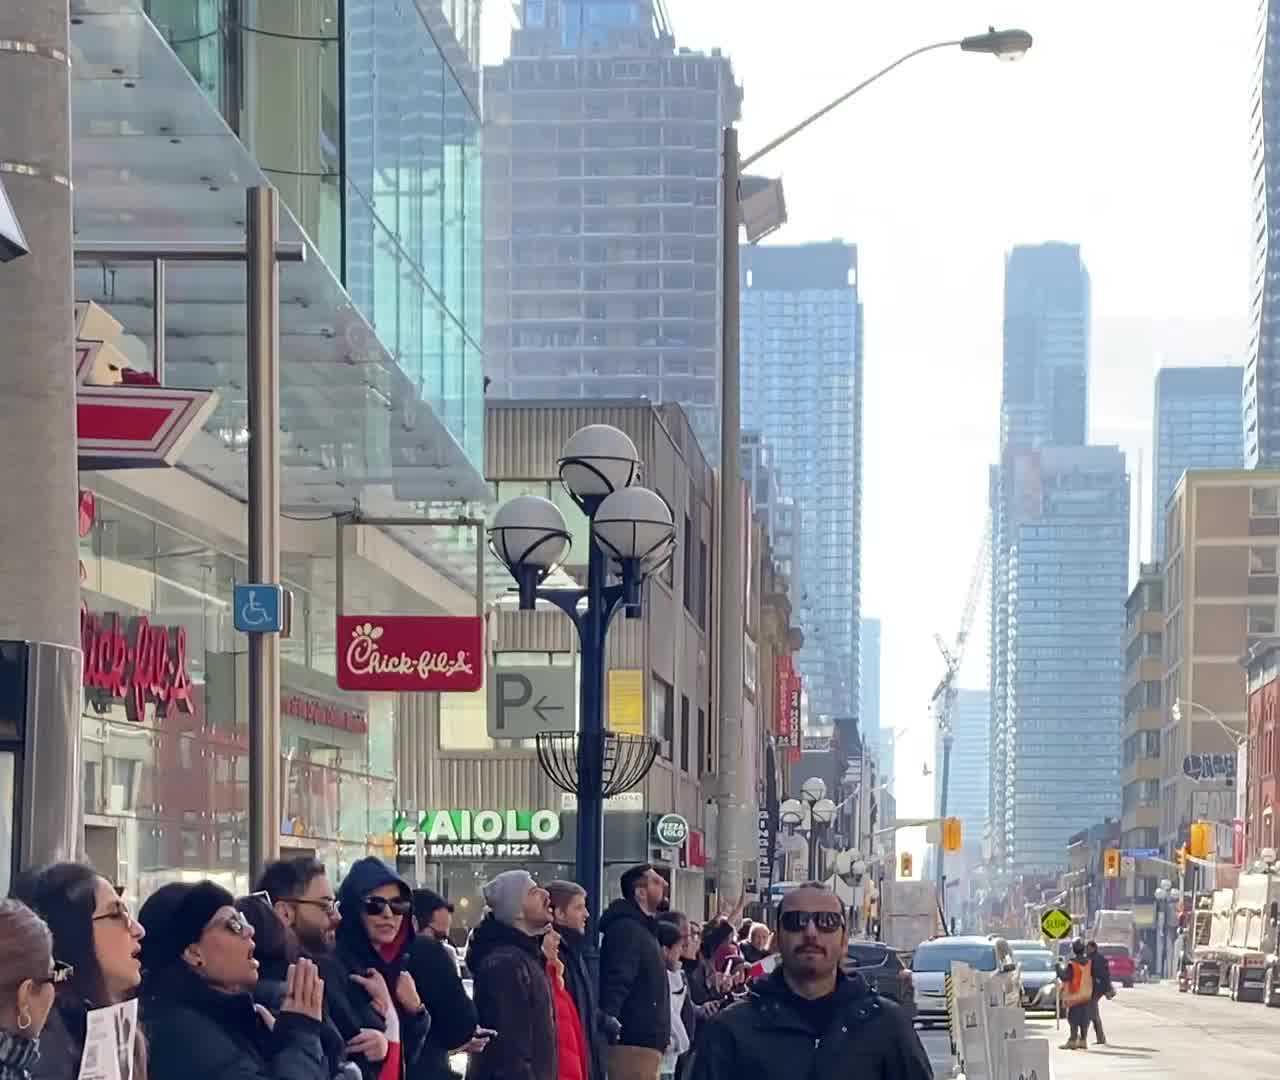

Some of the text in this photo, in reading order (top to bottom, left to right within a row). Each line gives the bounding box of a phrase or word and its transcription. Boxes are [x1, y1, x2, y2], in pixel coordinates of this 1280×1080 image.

[395, 808, 561, 841] ZAIOLO
[395, 843, 540, 856] IZZ MAKER'S PIZZA
